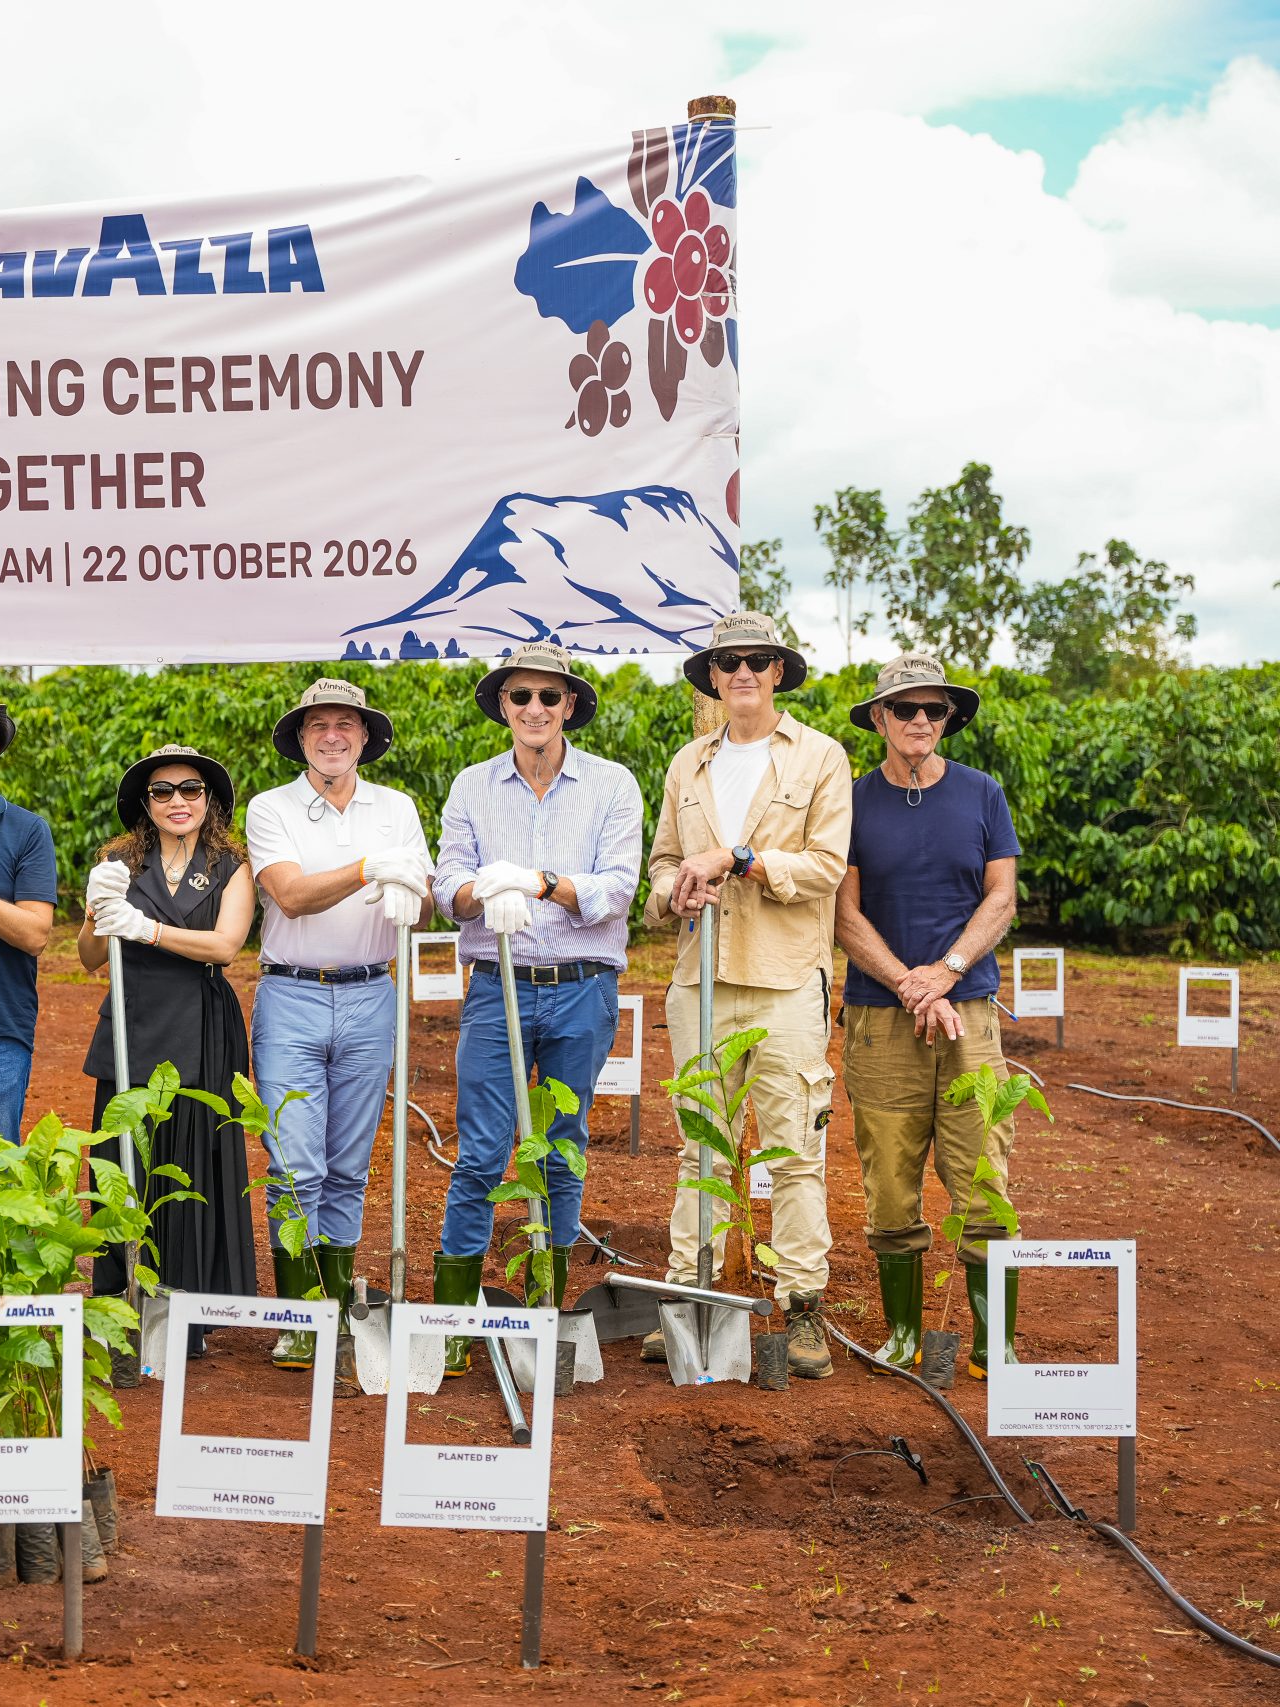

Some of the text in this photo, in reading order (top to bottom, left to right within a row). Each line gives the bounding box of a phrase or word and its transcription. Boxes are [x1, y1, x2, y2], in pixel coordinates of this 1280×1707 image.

[103, 350, 424, 415] CEREMONY
[83, 546, 127, 582] 22
[139, 542, 312, 581] OCTOBER
[324, 539, 417, 577] 2026
[1068, 1248, 1111, 1259] LAVAZZA
[6, 1304, 54, 1317] LAVAZZA
[264, 1310, 312, 1323] LAVAZZA
[482, 1316, 529, 1329] LAVAZZA
[201, 1446, 293, 1457] PLANTED TOGETHER
[438, 1453, 482, 1461] PLANTED
[214, 1494, 274, 1504] HAM RONG
[436, 1501, 495, 1510] HAM RONG
